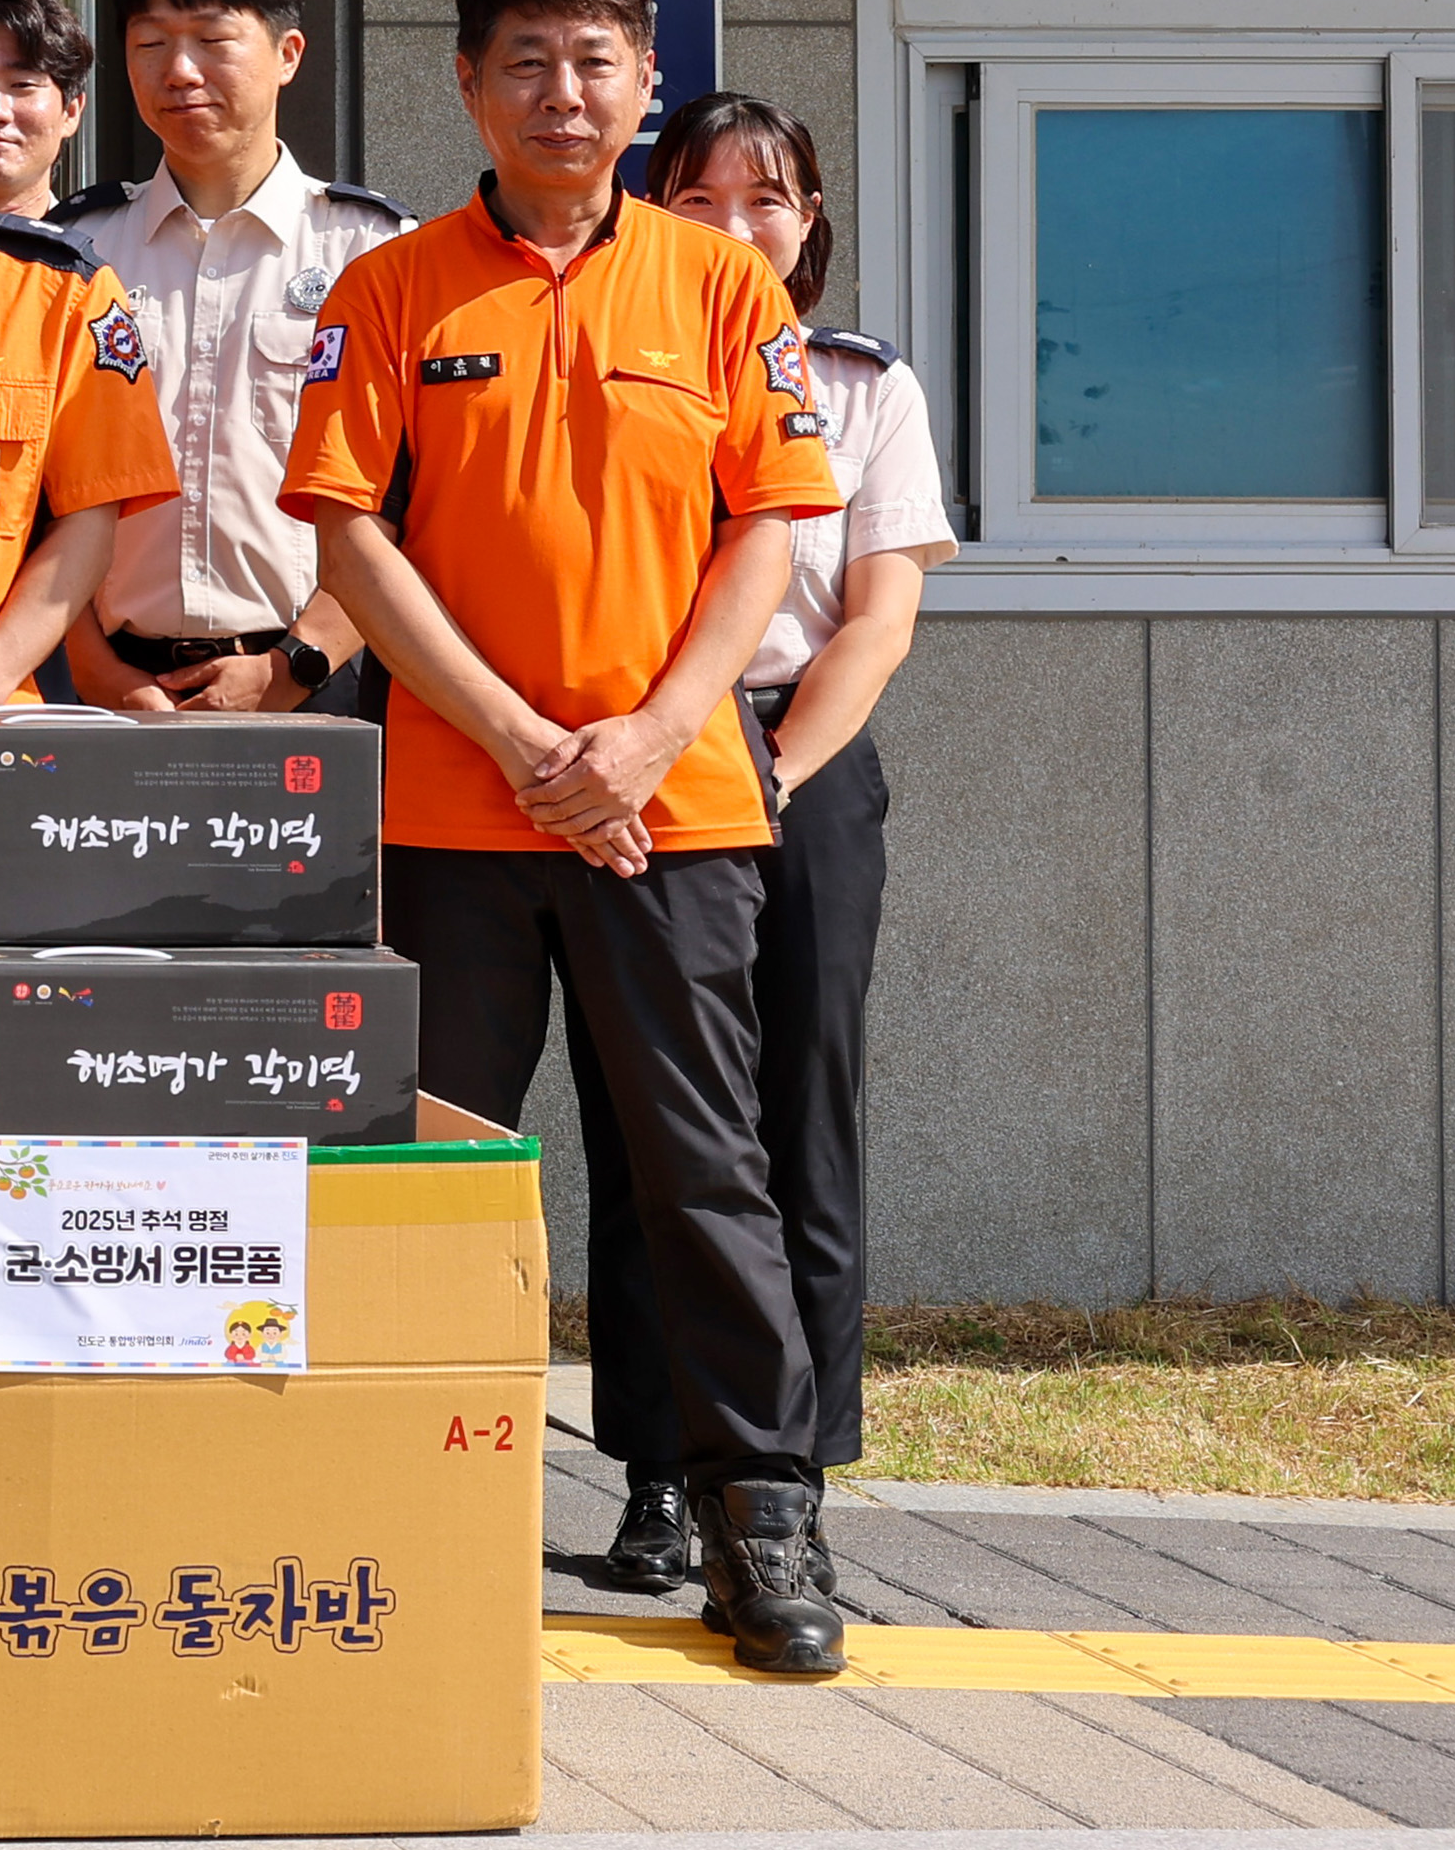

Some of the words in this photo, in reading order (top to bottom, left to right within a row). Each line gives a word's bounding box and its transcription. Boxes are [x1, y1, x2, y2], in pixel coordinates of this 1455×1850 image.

[31, 815, 189, 858] 해초명가
[67, 1050, 227, 1094] 해초명가
[281, 1150, 299, 1162] 진도
[62, 1210, 134, 1231] 2025년
[142, 1210, 181, 1231] 추석
[189, 1211, 227, 1231] 명절
[7, 1245, 161, 1283] 군·소방서
[174, 1246, 281, 1284] 위문품
[76, 1335, 106, 1348] 진도군
[109, 1335, 175, 1348] 통합방위협의회
[444, 1416, 514, 1451] A-2
[157, 1560, 392, 1652] 돌자반
